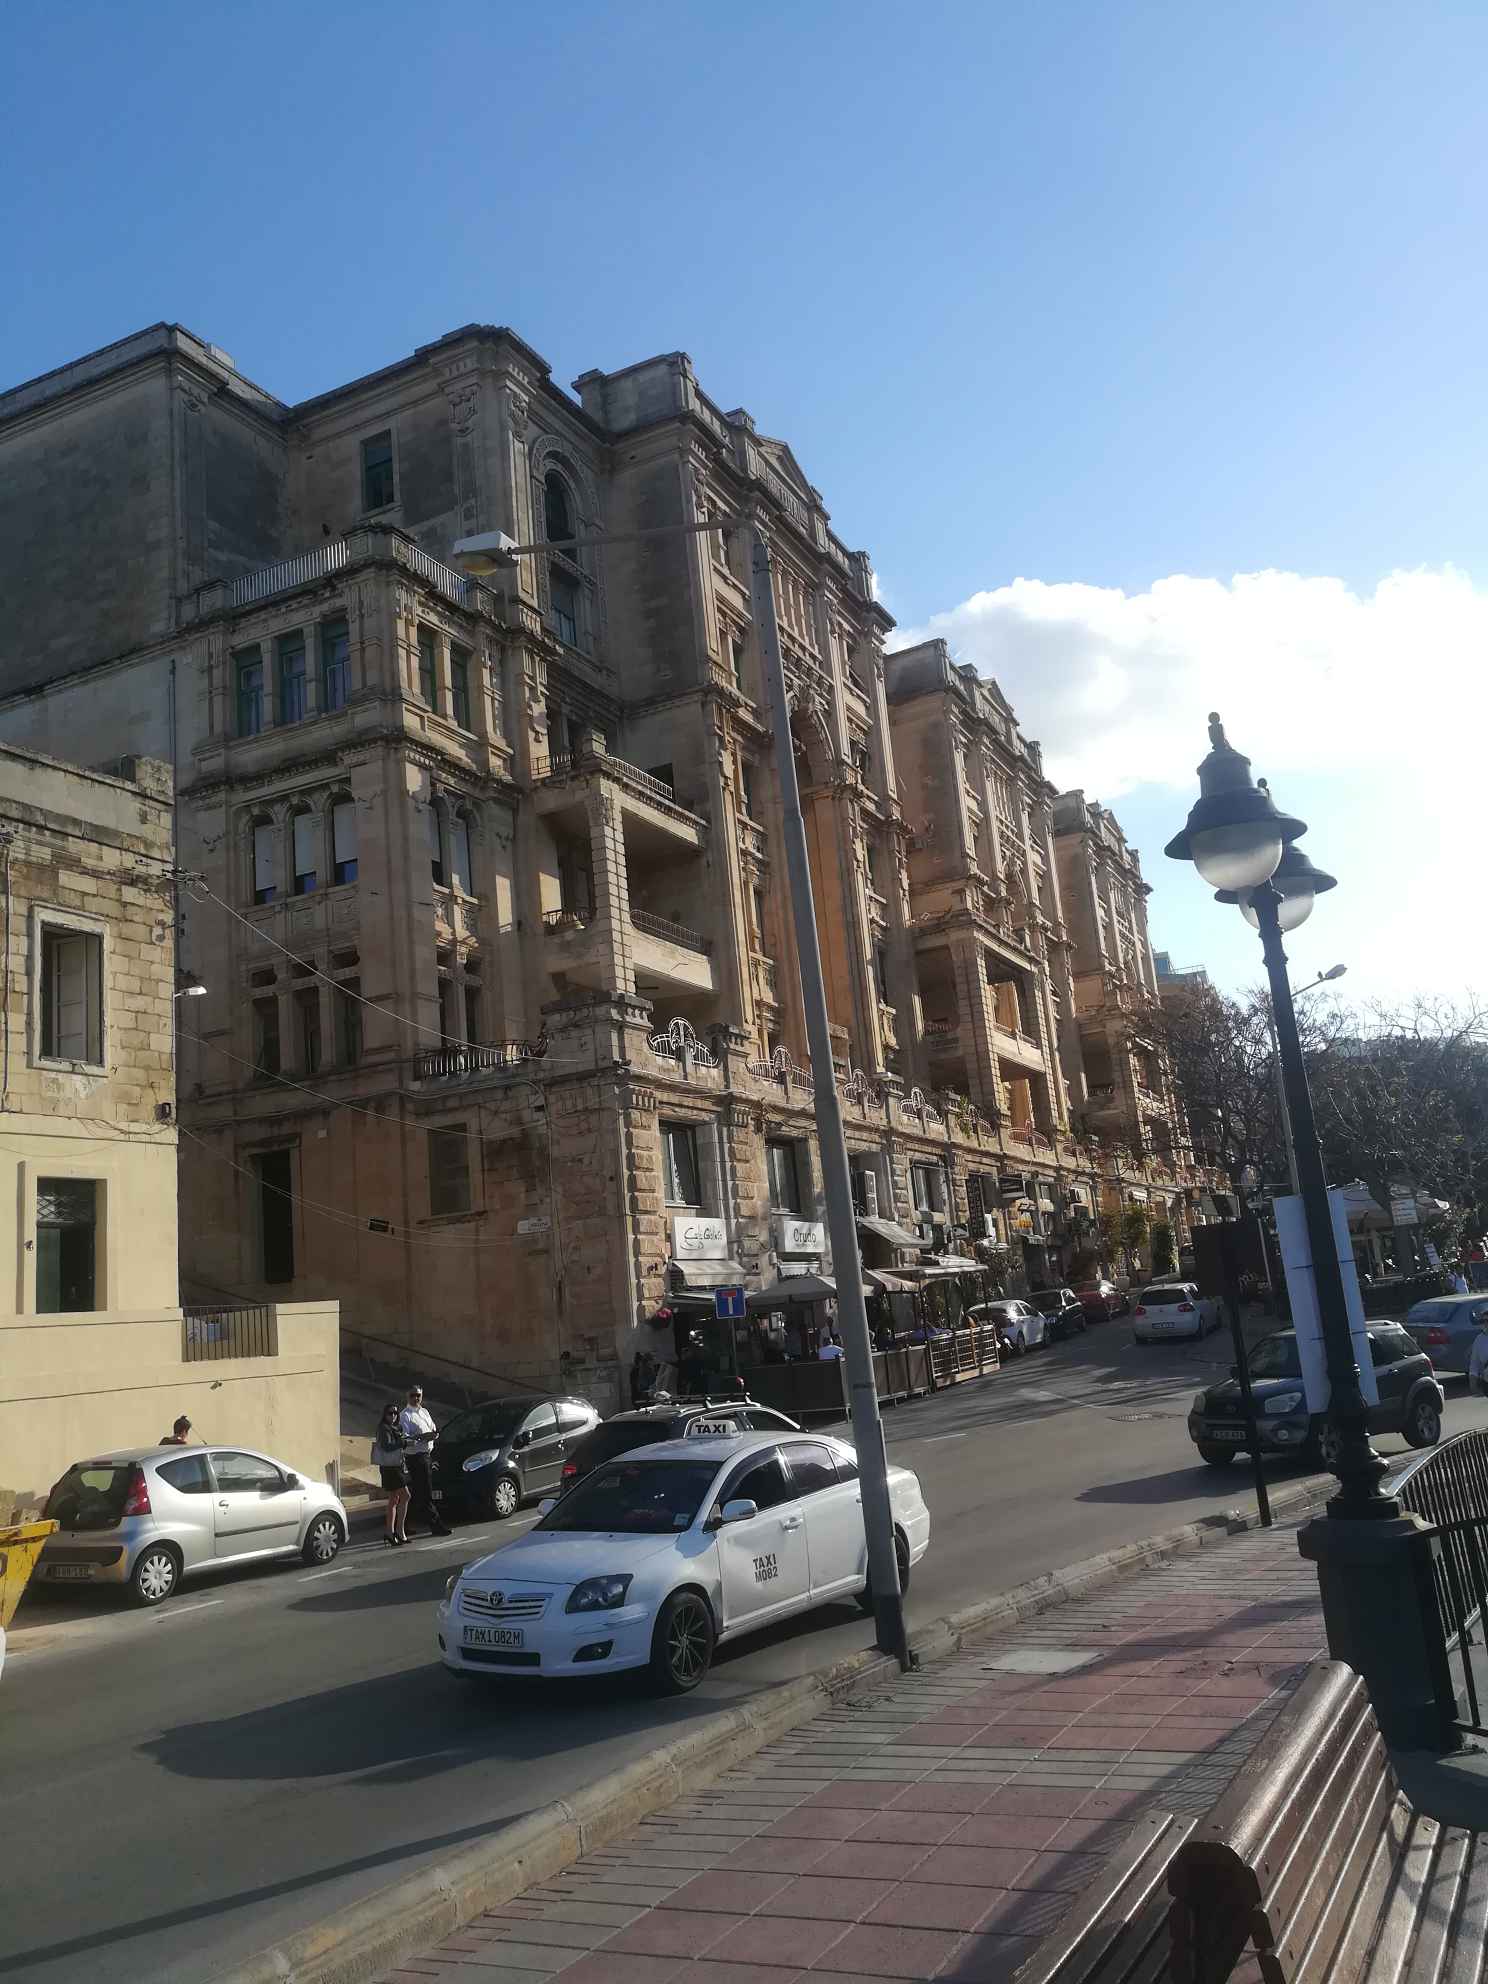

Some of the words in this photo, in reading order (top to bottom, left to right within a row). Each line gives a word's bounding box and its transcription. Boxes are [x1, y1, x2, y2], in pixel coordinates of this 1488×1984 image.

[695, 1423, 727, 1434] TAXI
[752, 1553, 777, 1570] TAXI
[754, 1566, 778, 1583] M082
